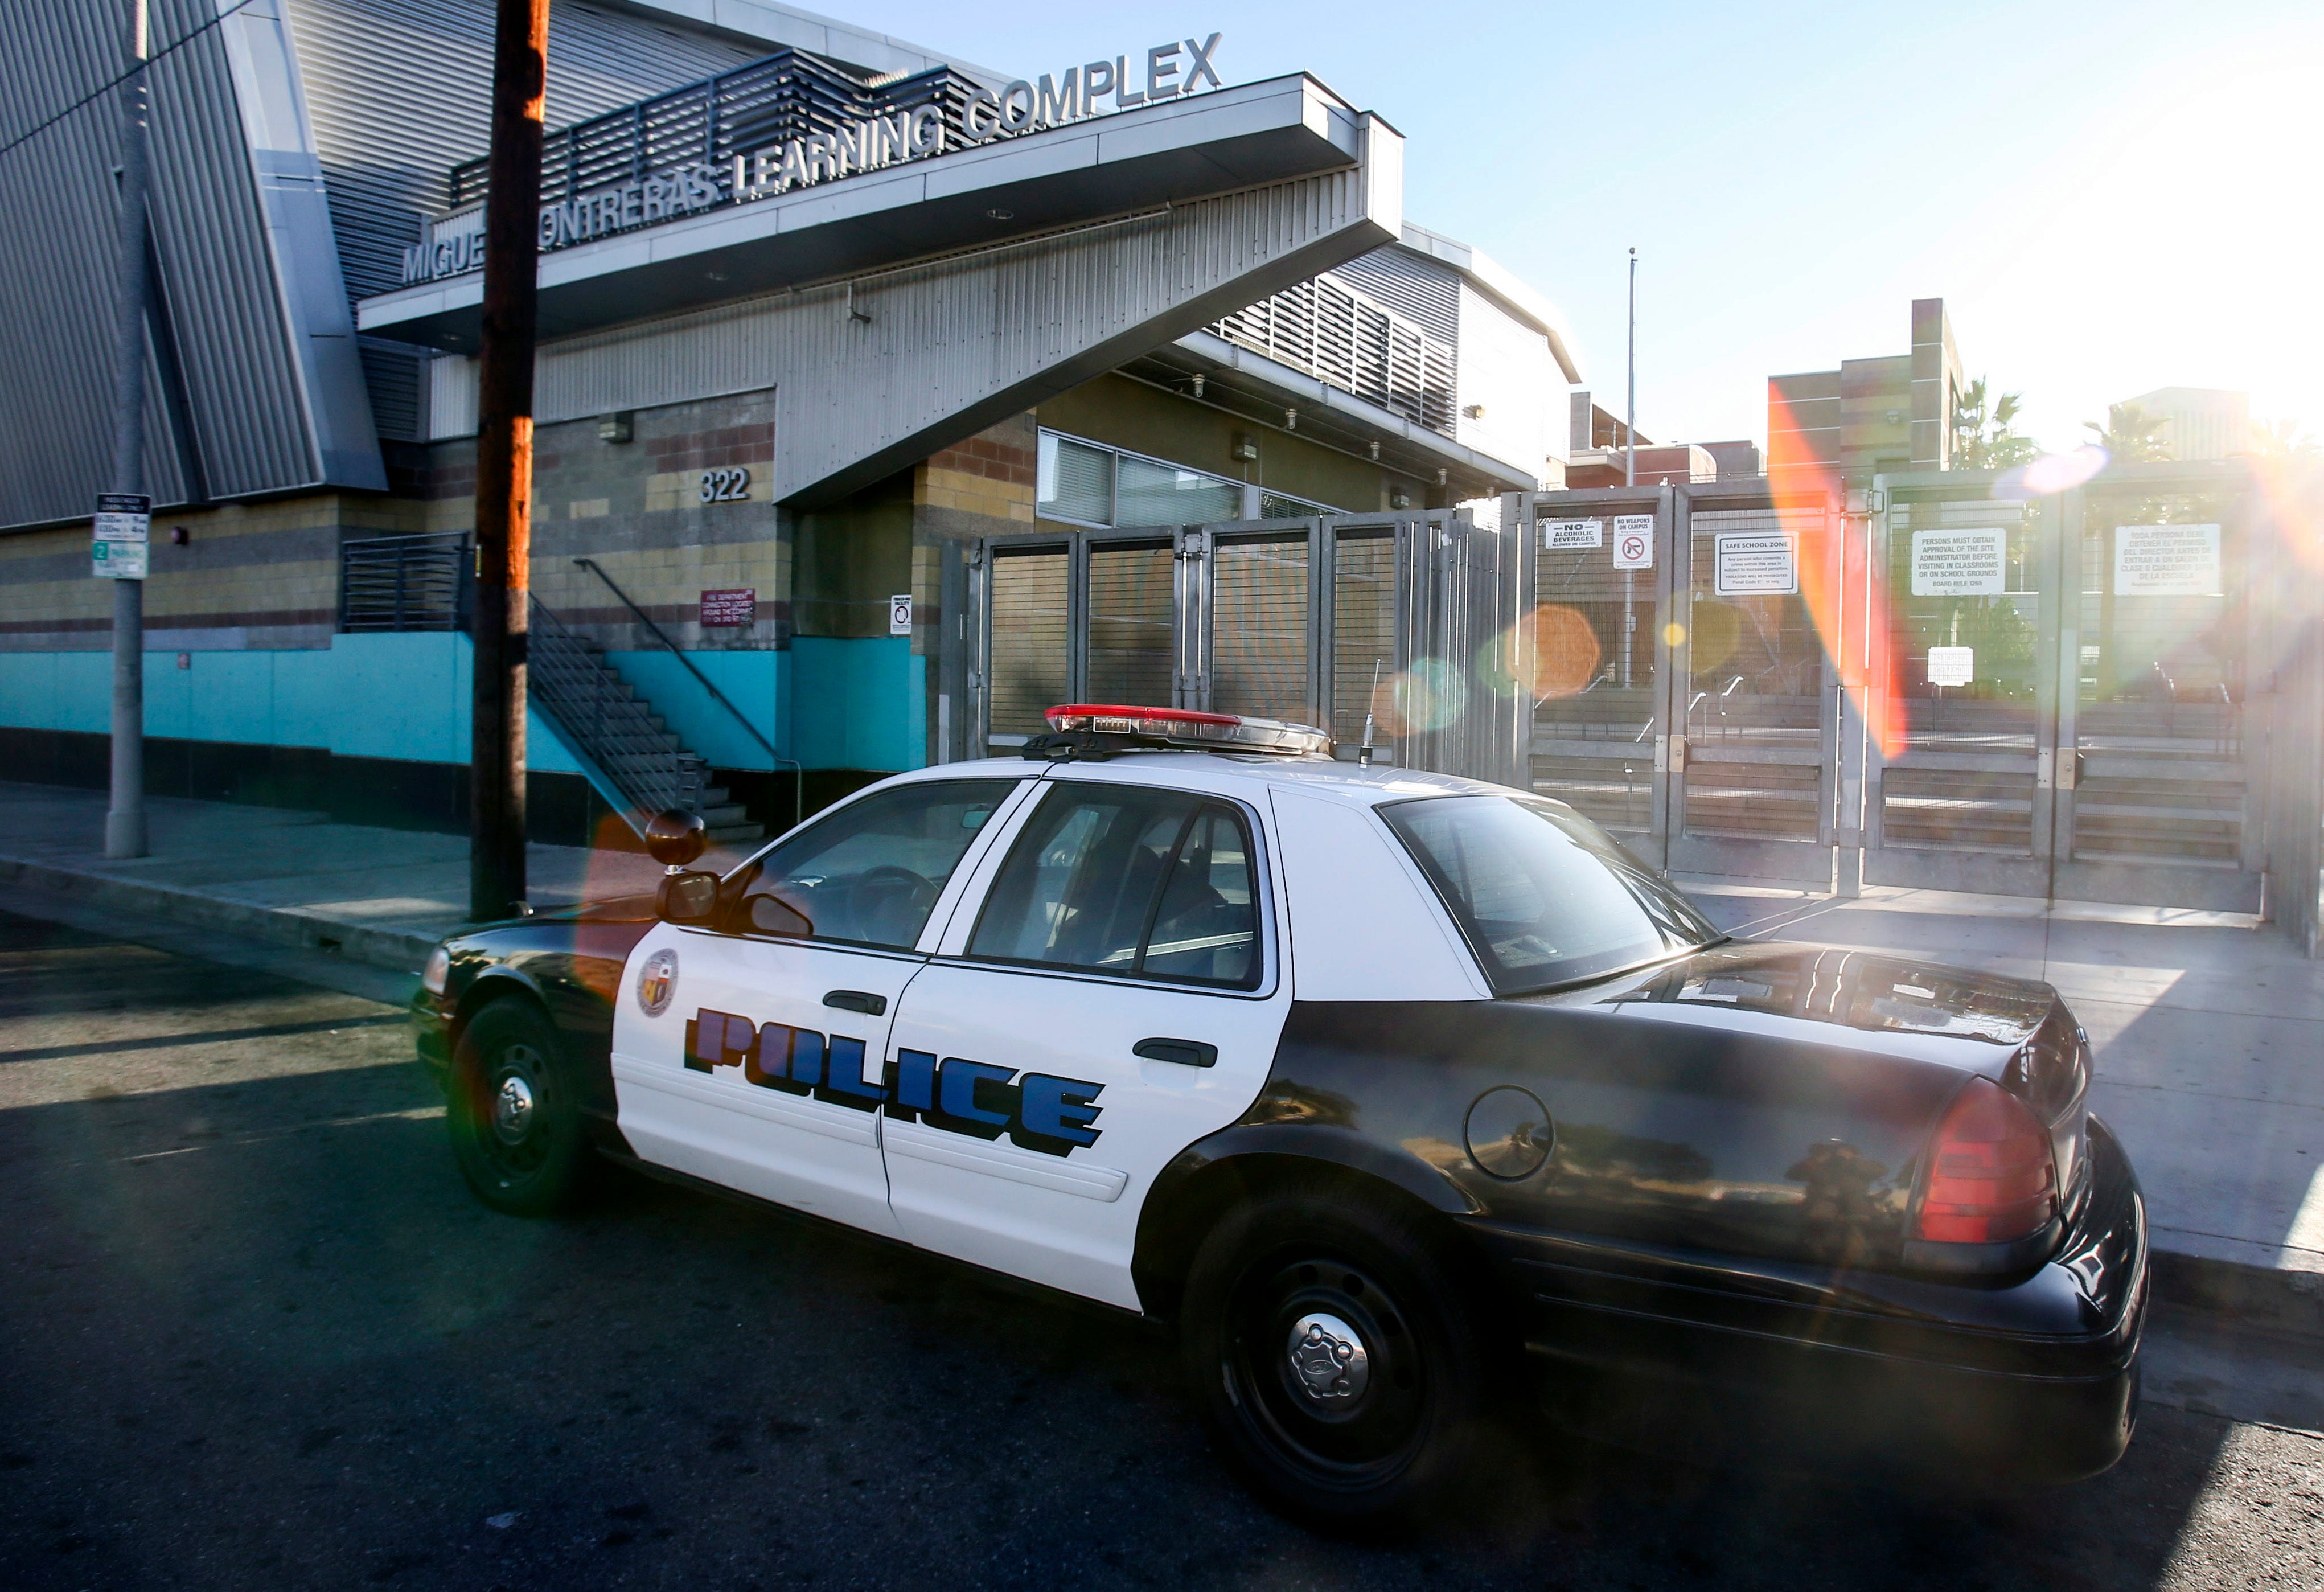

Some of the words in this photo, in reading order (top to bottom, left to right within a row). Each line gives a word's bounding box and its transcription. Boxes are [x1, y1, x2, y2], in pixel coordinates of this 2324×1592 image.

[402, 232, 486, 283] MIGUE
[538, 163, 720, 247] ONTRERAS
[732, 104, 945, 199] LEARNING
[962, 32, 1223, 139] COMPLEX
[699, 467, 750, 502] 322
[684, 1007, 1106, 1158] POLICE
